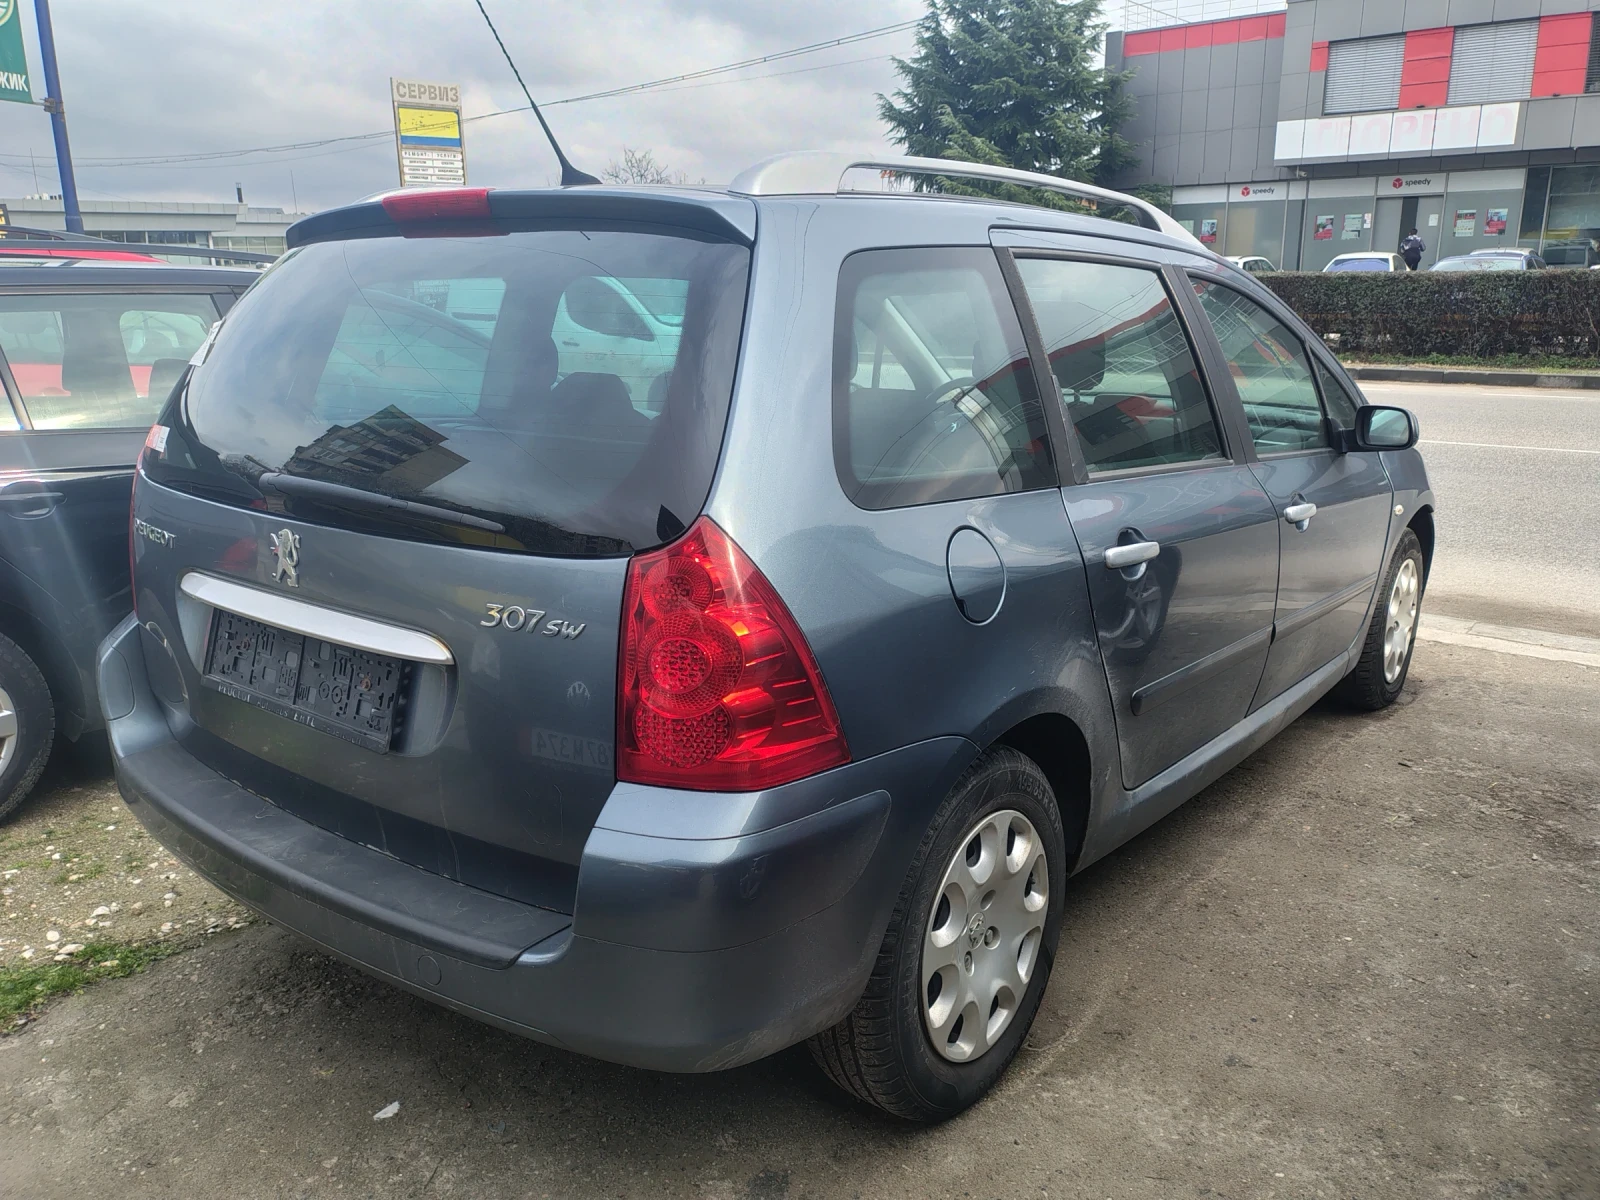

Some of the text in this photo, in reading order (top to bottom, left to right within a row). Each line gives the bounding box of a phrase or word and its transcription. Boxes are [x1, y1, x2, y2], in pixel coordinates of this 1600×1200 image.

[396, 82, 459, 102] СЕРВИЗ
[1252, 187, 1275, 195] speedy
[1405, 178, 1431, 187] speedy
[134, 517, 177, 548] PEUGEOT
[480, 603, 546, 633] 307
